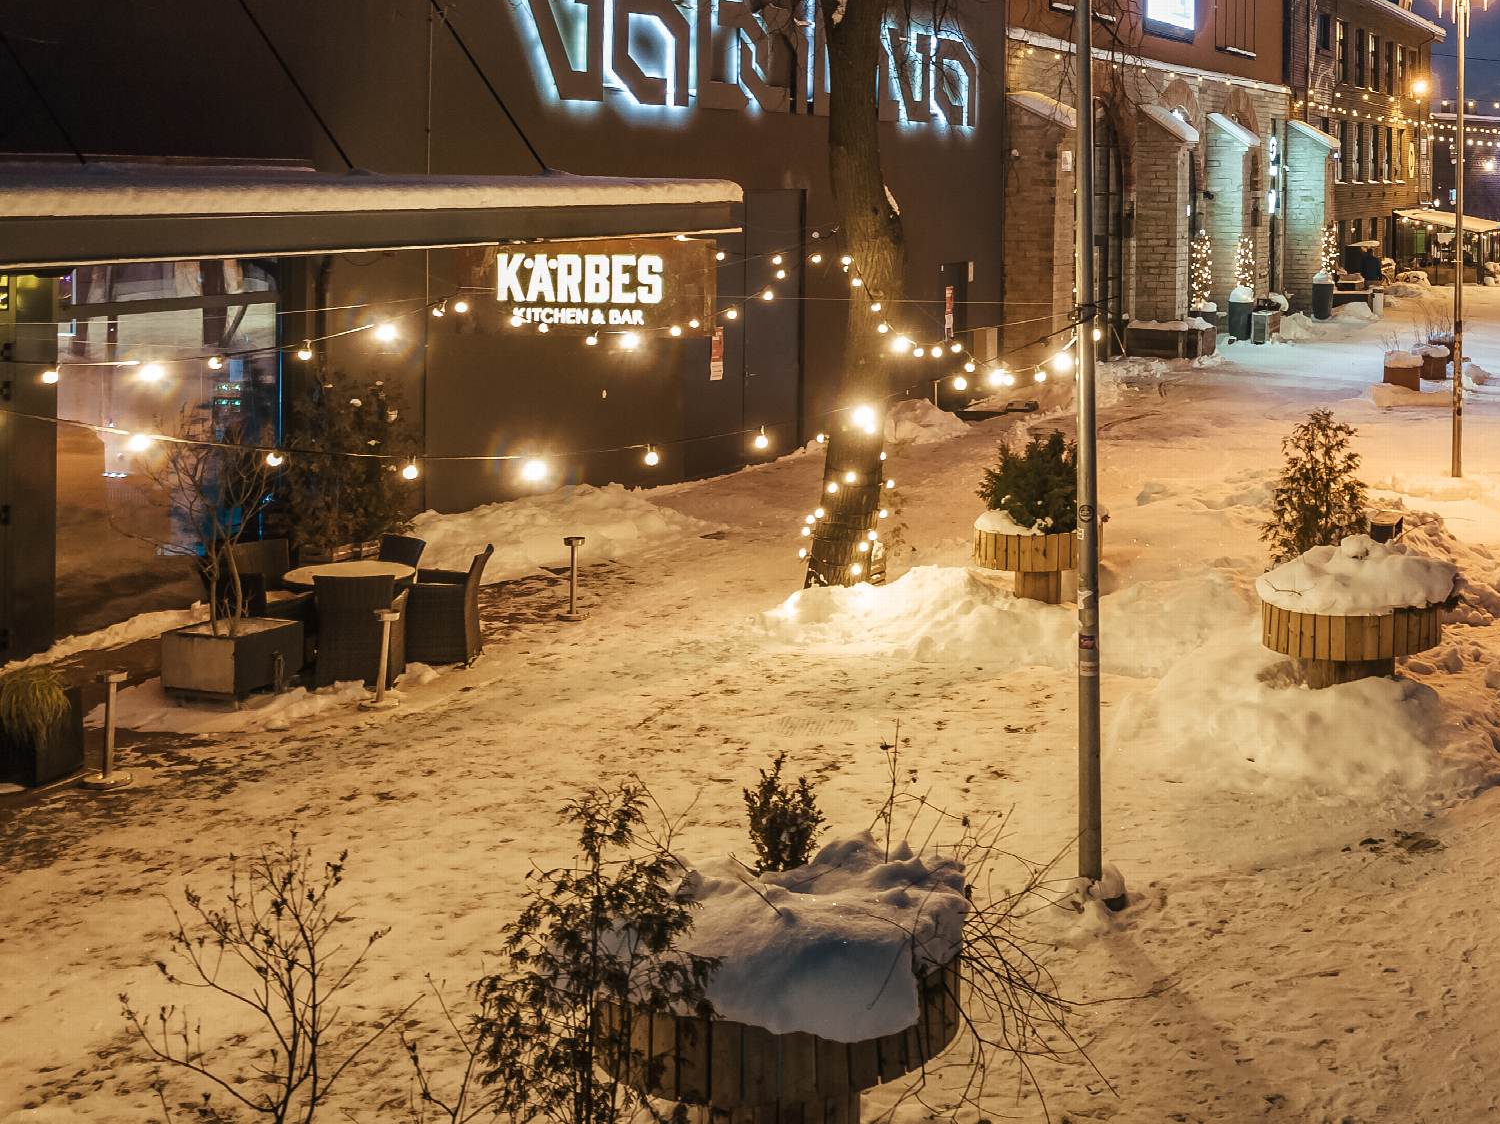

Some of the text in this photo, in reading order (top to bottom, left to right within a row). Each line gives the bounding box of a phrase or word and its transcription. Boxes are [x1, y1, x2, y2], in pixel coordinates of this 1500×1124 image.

[496, 253, 664, 304] KÄRBES
[512, 307, 645, 326] KITCHEN & BAR
